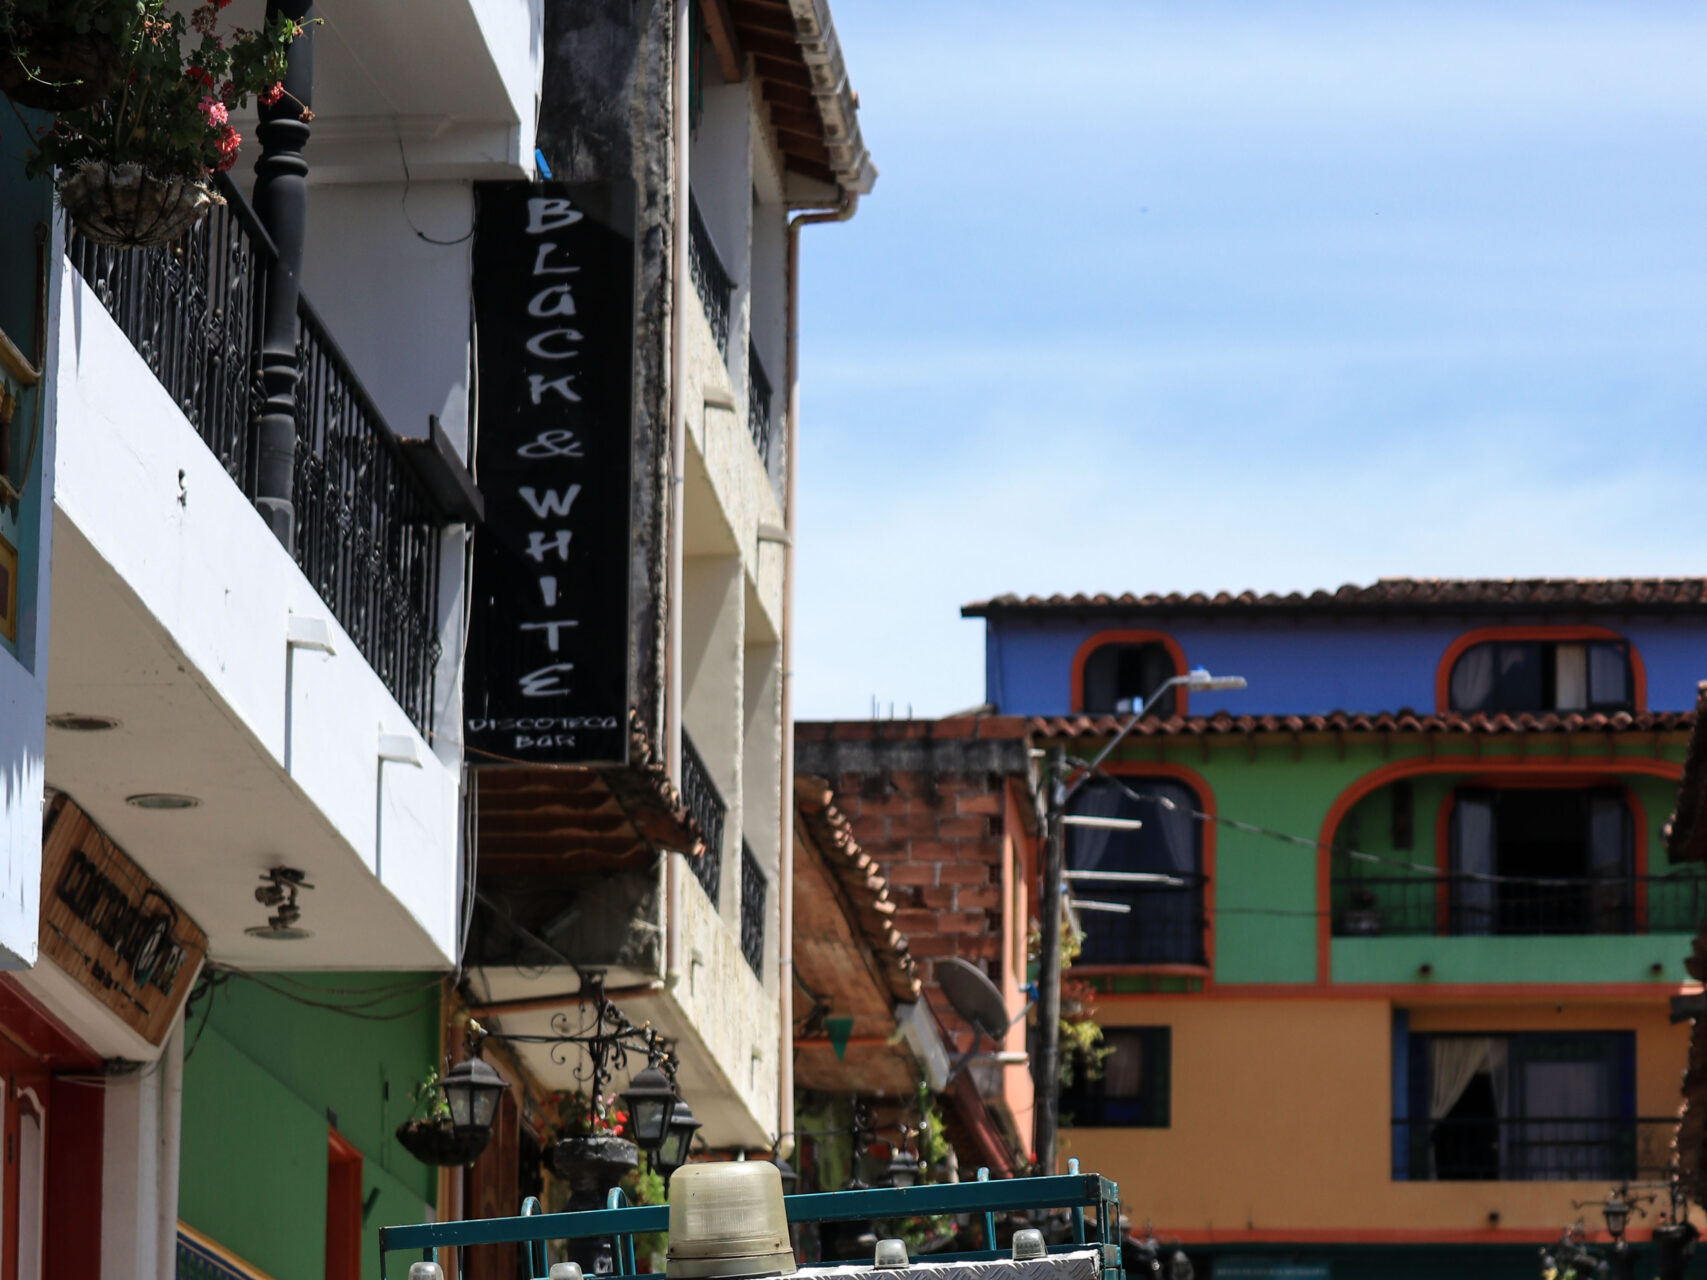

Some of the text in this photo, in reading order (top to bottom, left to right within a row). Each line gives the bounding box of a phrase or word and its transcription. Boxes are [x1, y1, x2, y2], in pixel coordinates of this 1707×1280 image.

[517, 429, 584, 458] &
[518, 484, 582, 696] WHITE
[515, 734, 575, 749] BAR
